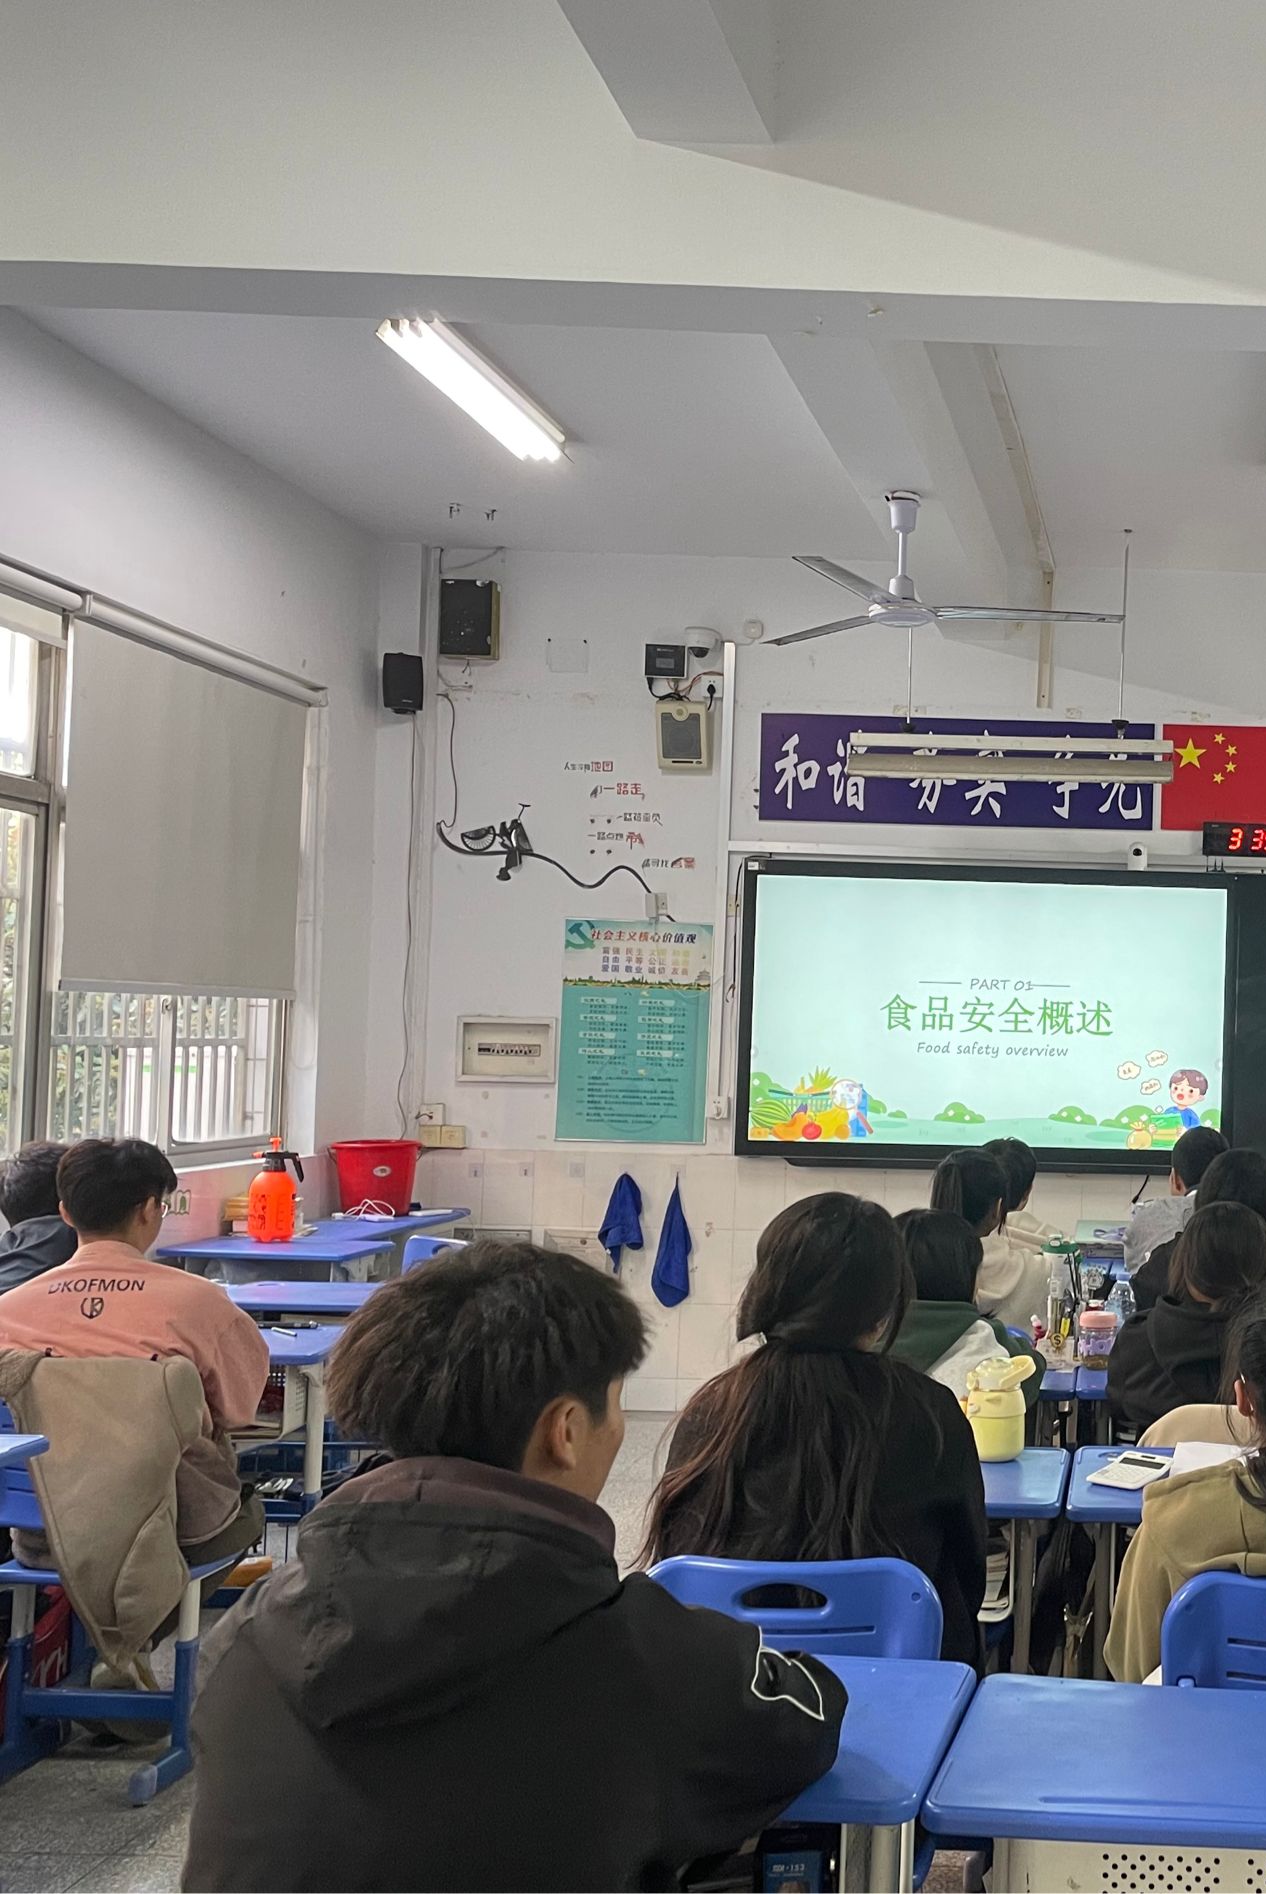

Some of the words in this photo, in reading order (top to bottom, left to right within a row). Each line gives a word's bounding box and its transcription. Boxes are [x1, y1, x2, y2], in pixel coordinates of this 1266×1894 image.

[591, 929, 697, 944] 社会主义核心价值观
[970, 978, 1010, 991] PART
[1014, 980, 1034, 991] 01
[879, 993, 1114, 1037] 食品安全概述
[917, 1041, 951, 1055] Food
[957, 1042, 1000, 1059] safety
[1005, 1044, 1069, 1057] overview
